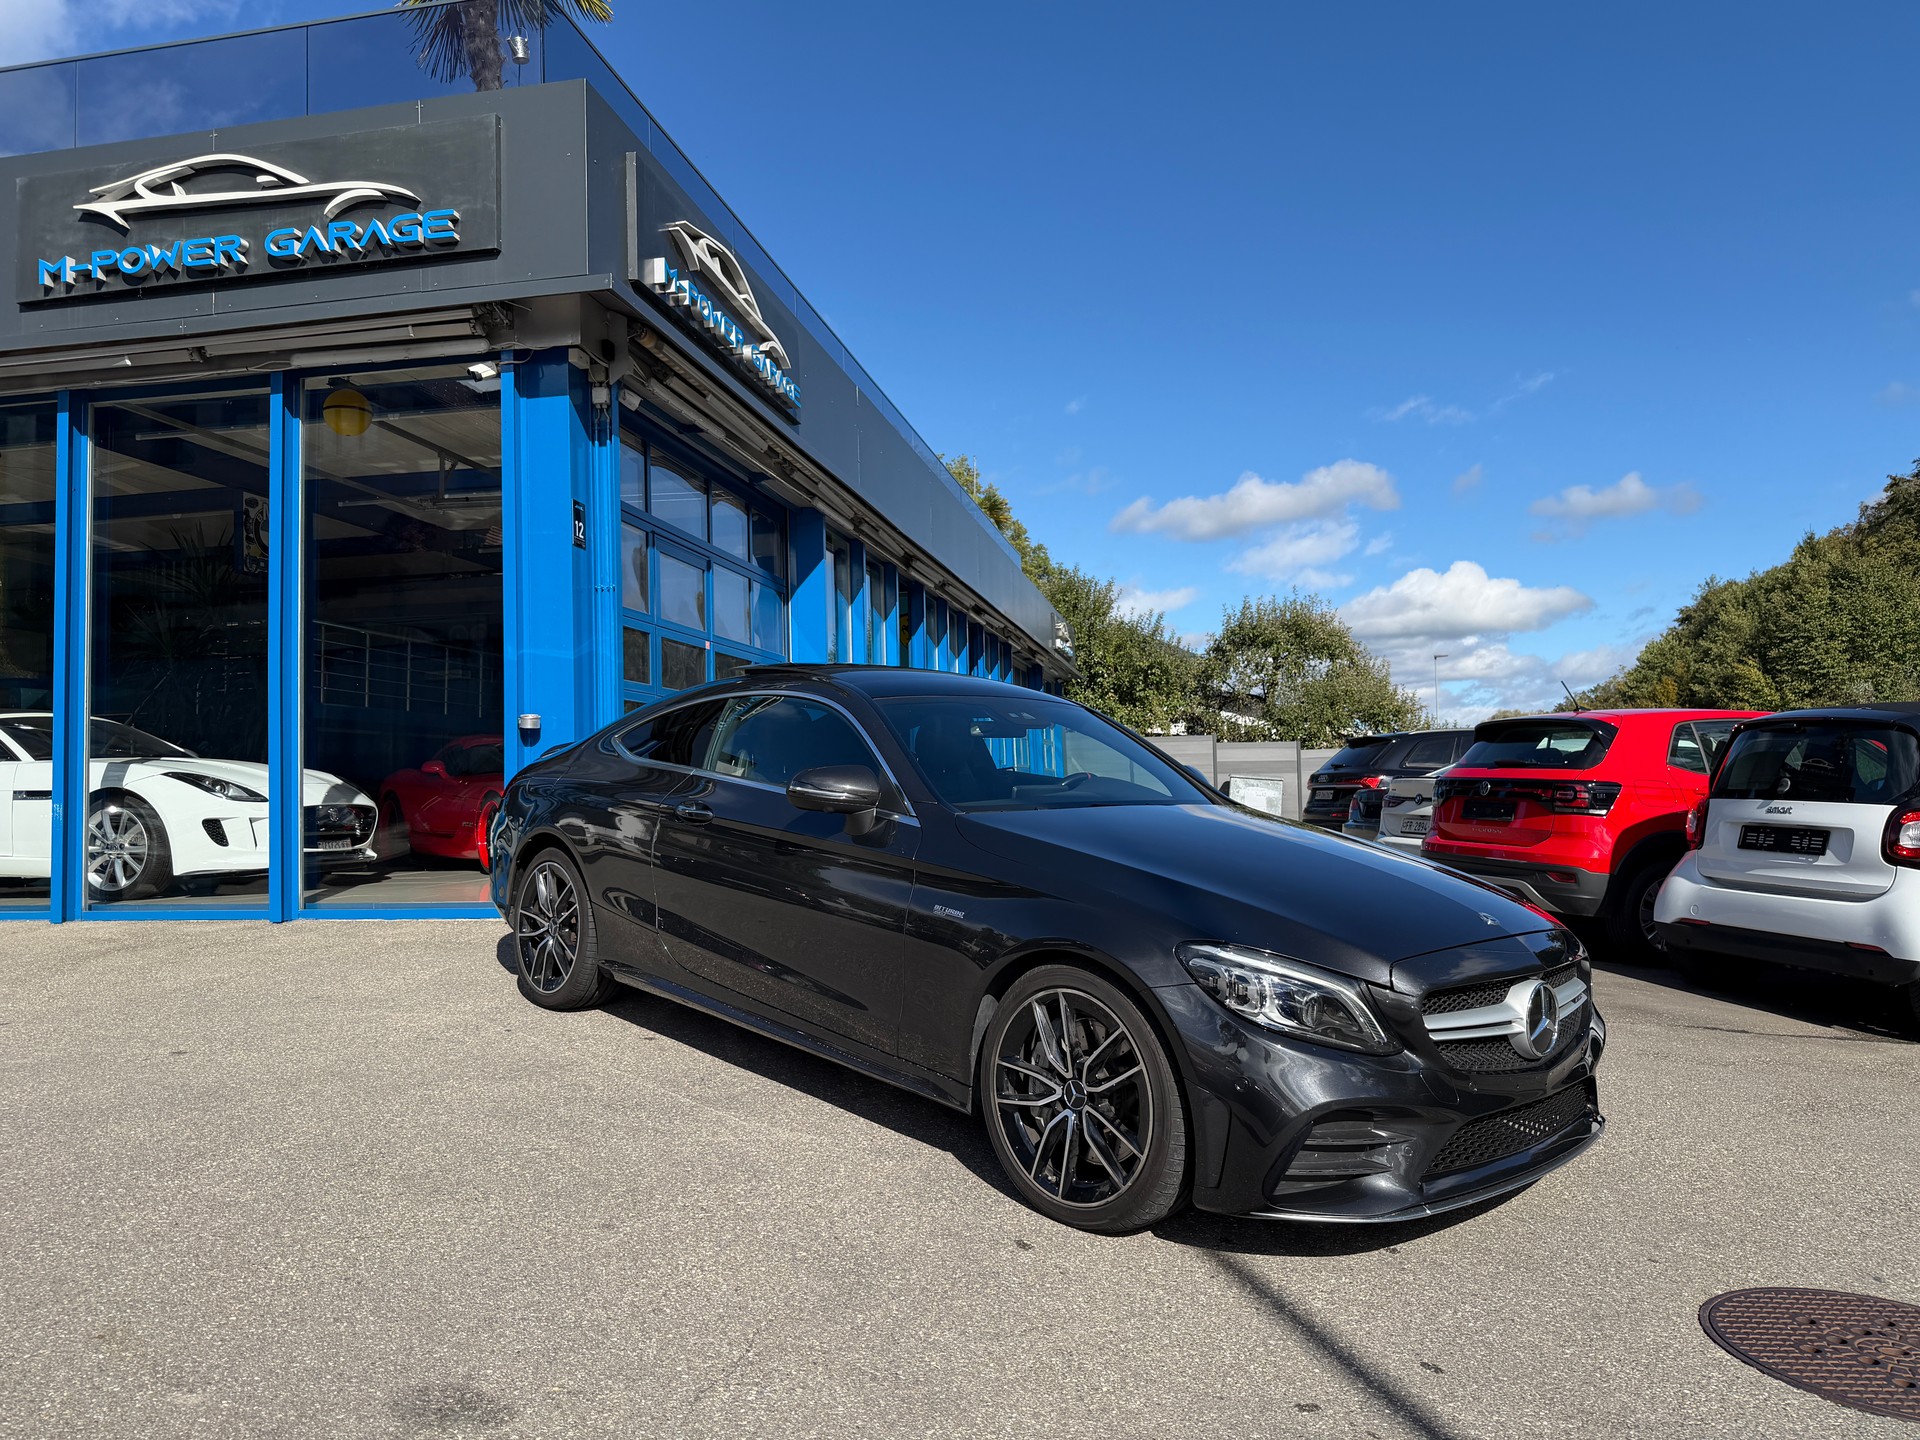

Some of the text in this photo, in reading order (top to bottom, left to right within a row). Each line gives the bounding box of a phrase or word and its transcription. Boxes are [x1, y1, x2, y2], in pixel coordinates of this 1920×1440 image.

[38, 208, 461, 287] M-POWER GARAGE
[575, 520, 584, 539] 12
[1765, 806, 1793, 815] smart
